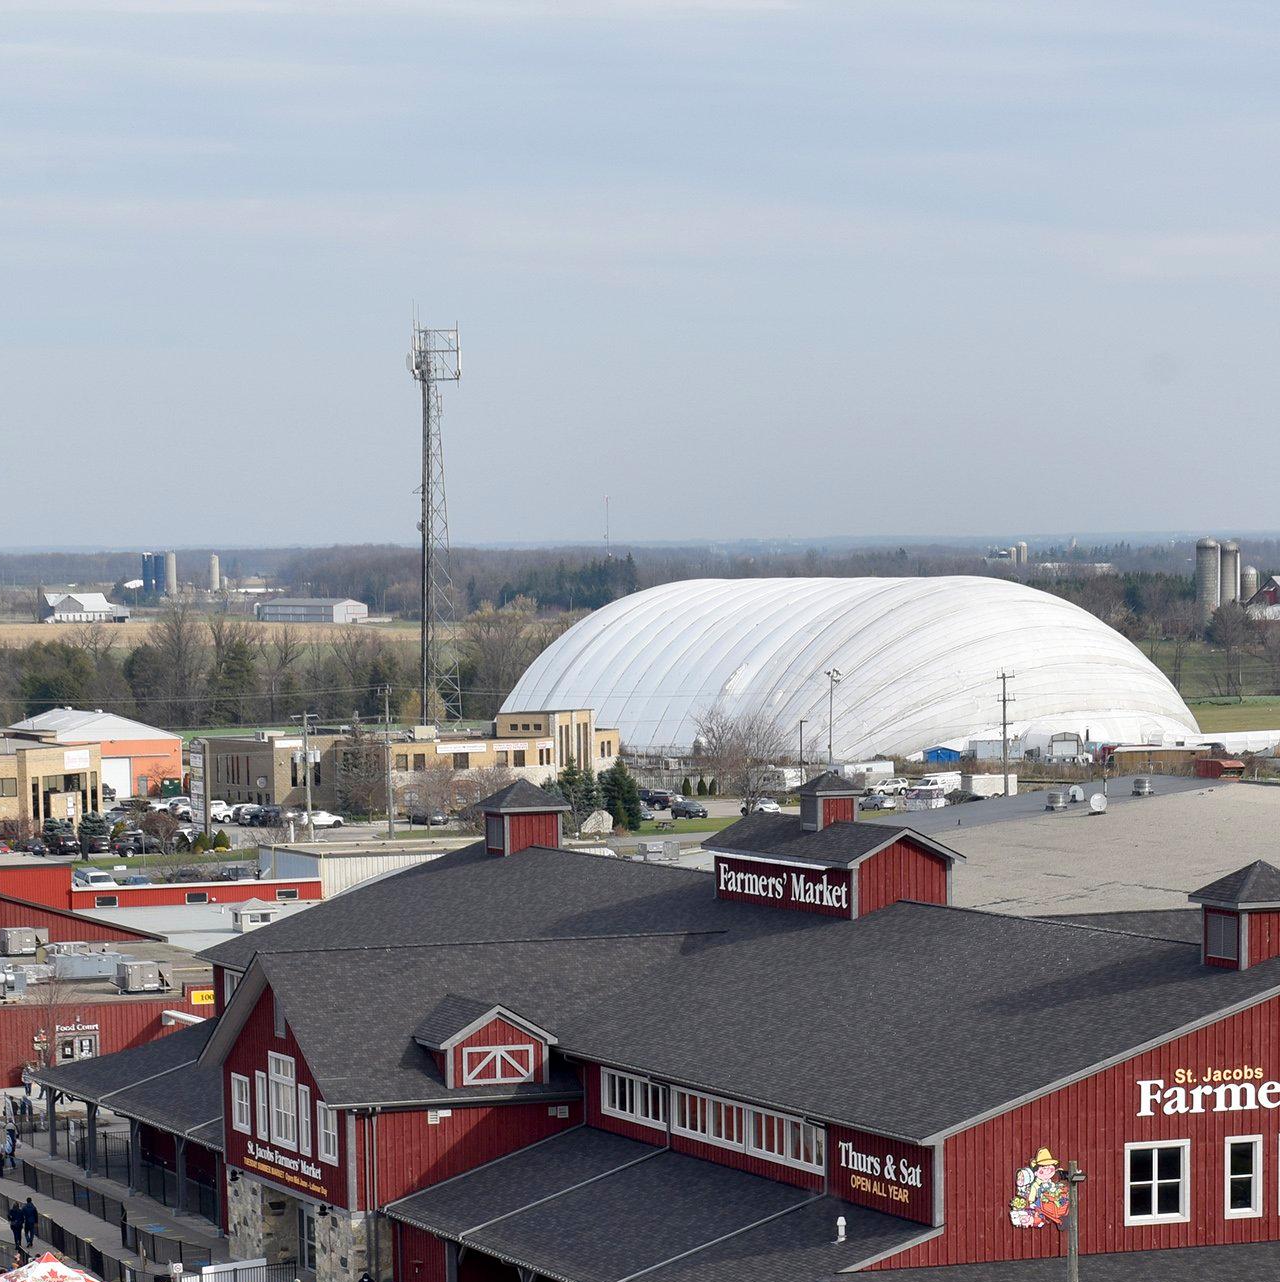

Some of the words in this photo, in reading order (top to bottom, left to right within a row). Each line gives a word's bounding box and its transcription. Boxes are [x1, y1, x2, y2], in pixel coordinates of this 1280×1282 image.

[718, 862, 788, 900] Farmers'
[790, 872, 848, 909] Market
[55, 1024, 75, 1032] Food
[76, 1023, 99, 1031] Court
[1174, 1067, 1197, 1084] St.
[1202, 1064, 1264, 1083] Jacobs
[247, 1140, 255, 1155] St.
[255, 1143, 275, 1162] Jacobs
[274, 1150, 300, 1171] Farmers'
[300, 1159, 322, 1180] Market
[838, 1140, 881, 1176] Thurs
[884, 1154, 897, 1181] &
[899, 1158, 923, 1188] Sat
[850, 1174, 871, 1193] OPEN
[872, 1181, 887, 1197] ALL
[888, 1184, 910, 1203] YEAR
